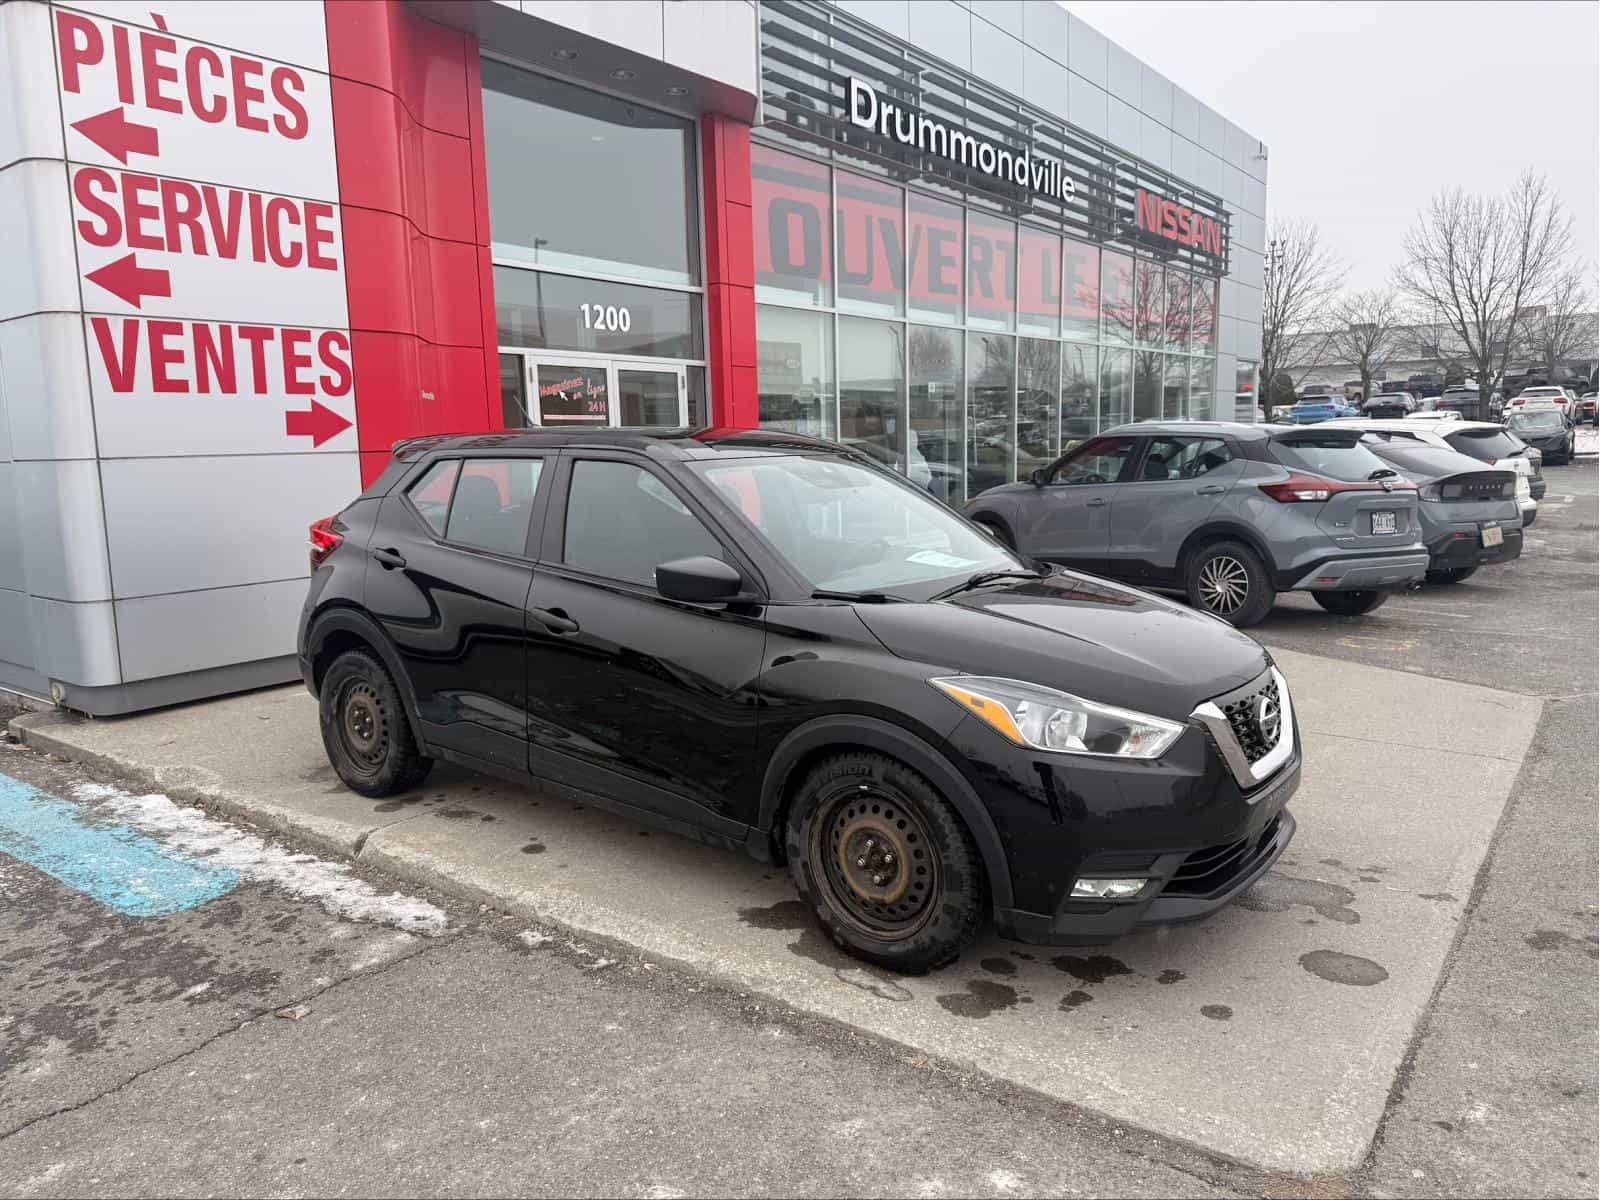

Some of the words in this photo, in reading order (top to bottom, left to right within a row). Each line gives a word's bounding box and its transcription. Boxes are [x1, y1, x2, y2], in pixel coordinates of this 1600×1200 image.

[55, 12, 309, 140] PIÈCES
[849, 75, 1077, 203] Drummondville
[73, 166, 338, 272] SERVICE
[768, 196, 1024, 300] OUVERT
[1136, 190, 1222, 257] NISSAN
[90, 316, 353, 398] VENTES
[580, 303, 631, 332] 1200
